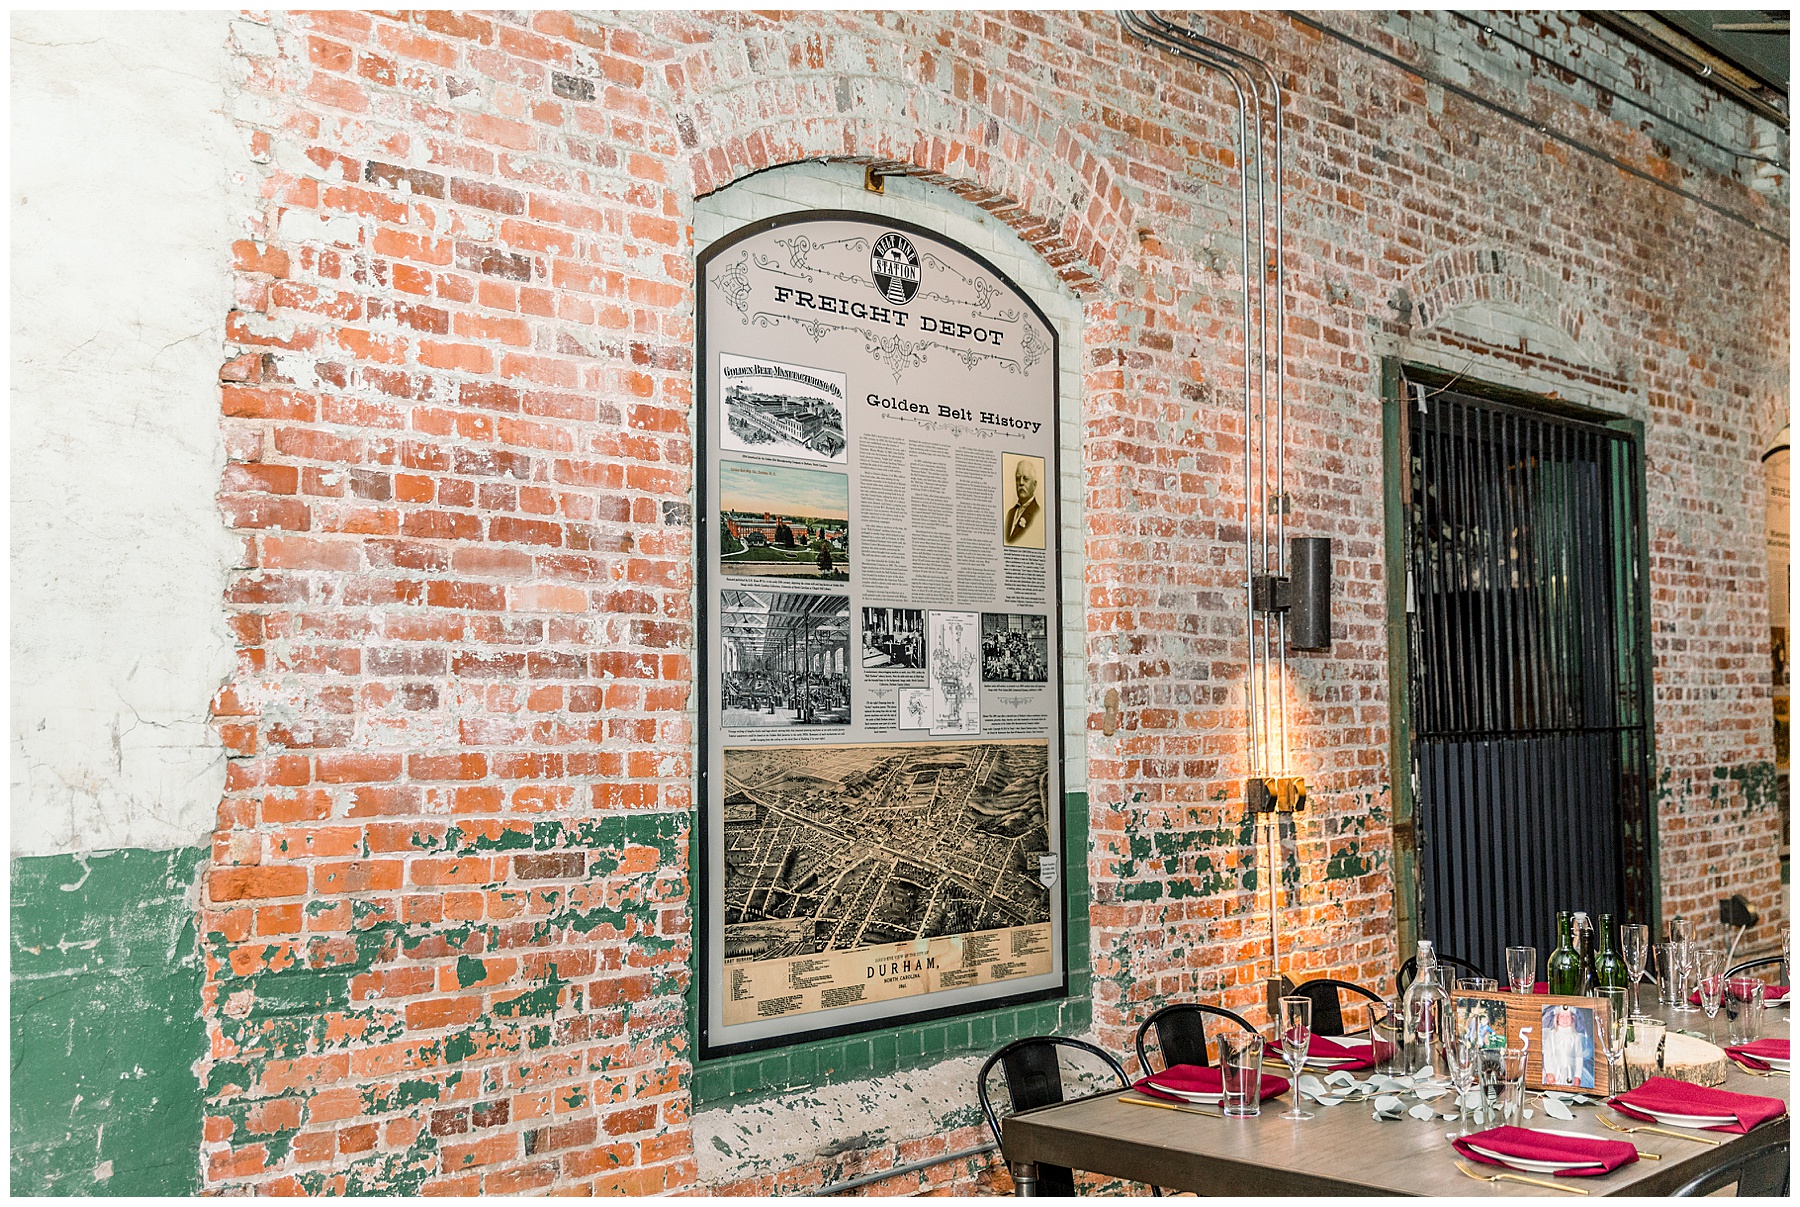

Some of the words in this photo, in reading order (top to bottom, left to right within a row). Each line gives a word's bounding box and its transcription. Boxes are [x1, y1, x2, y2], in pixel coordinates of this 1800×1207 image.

[876, 235, 896, 256] BELT
[898, 237, 917, 262] LINE
[876, 259, 916, 280] STATION
[774, 285, 909, 327] FREIGHT
[920, 315, 1004, 346] DEPOT
[866, 394, 930, 415] Golden
[937, 404, 973, 421] Belt
[979, 411, 1042, 434] History
[1518, 1027, 1533, 1052] 5
